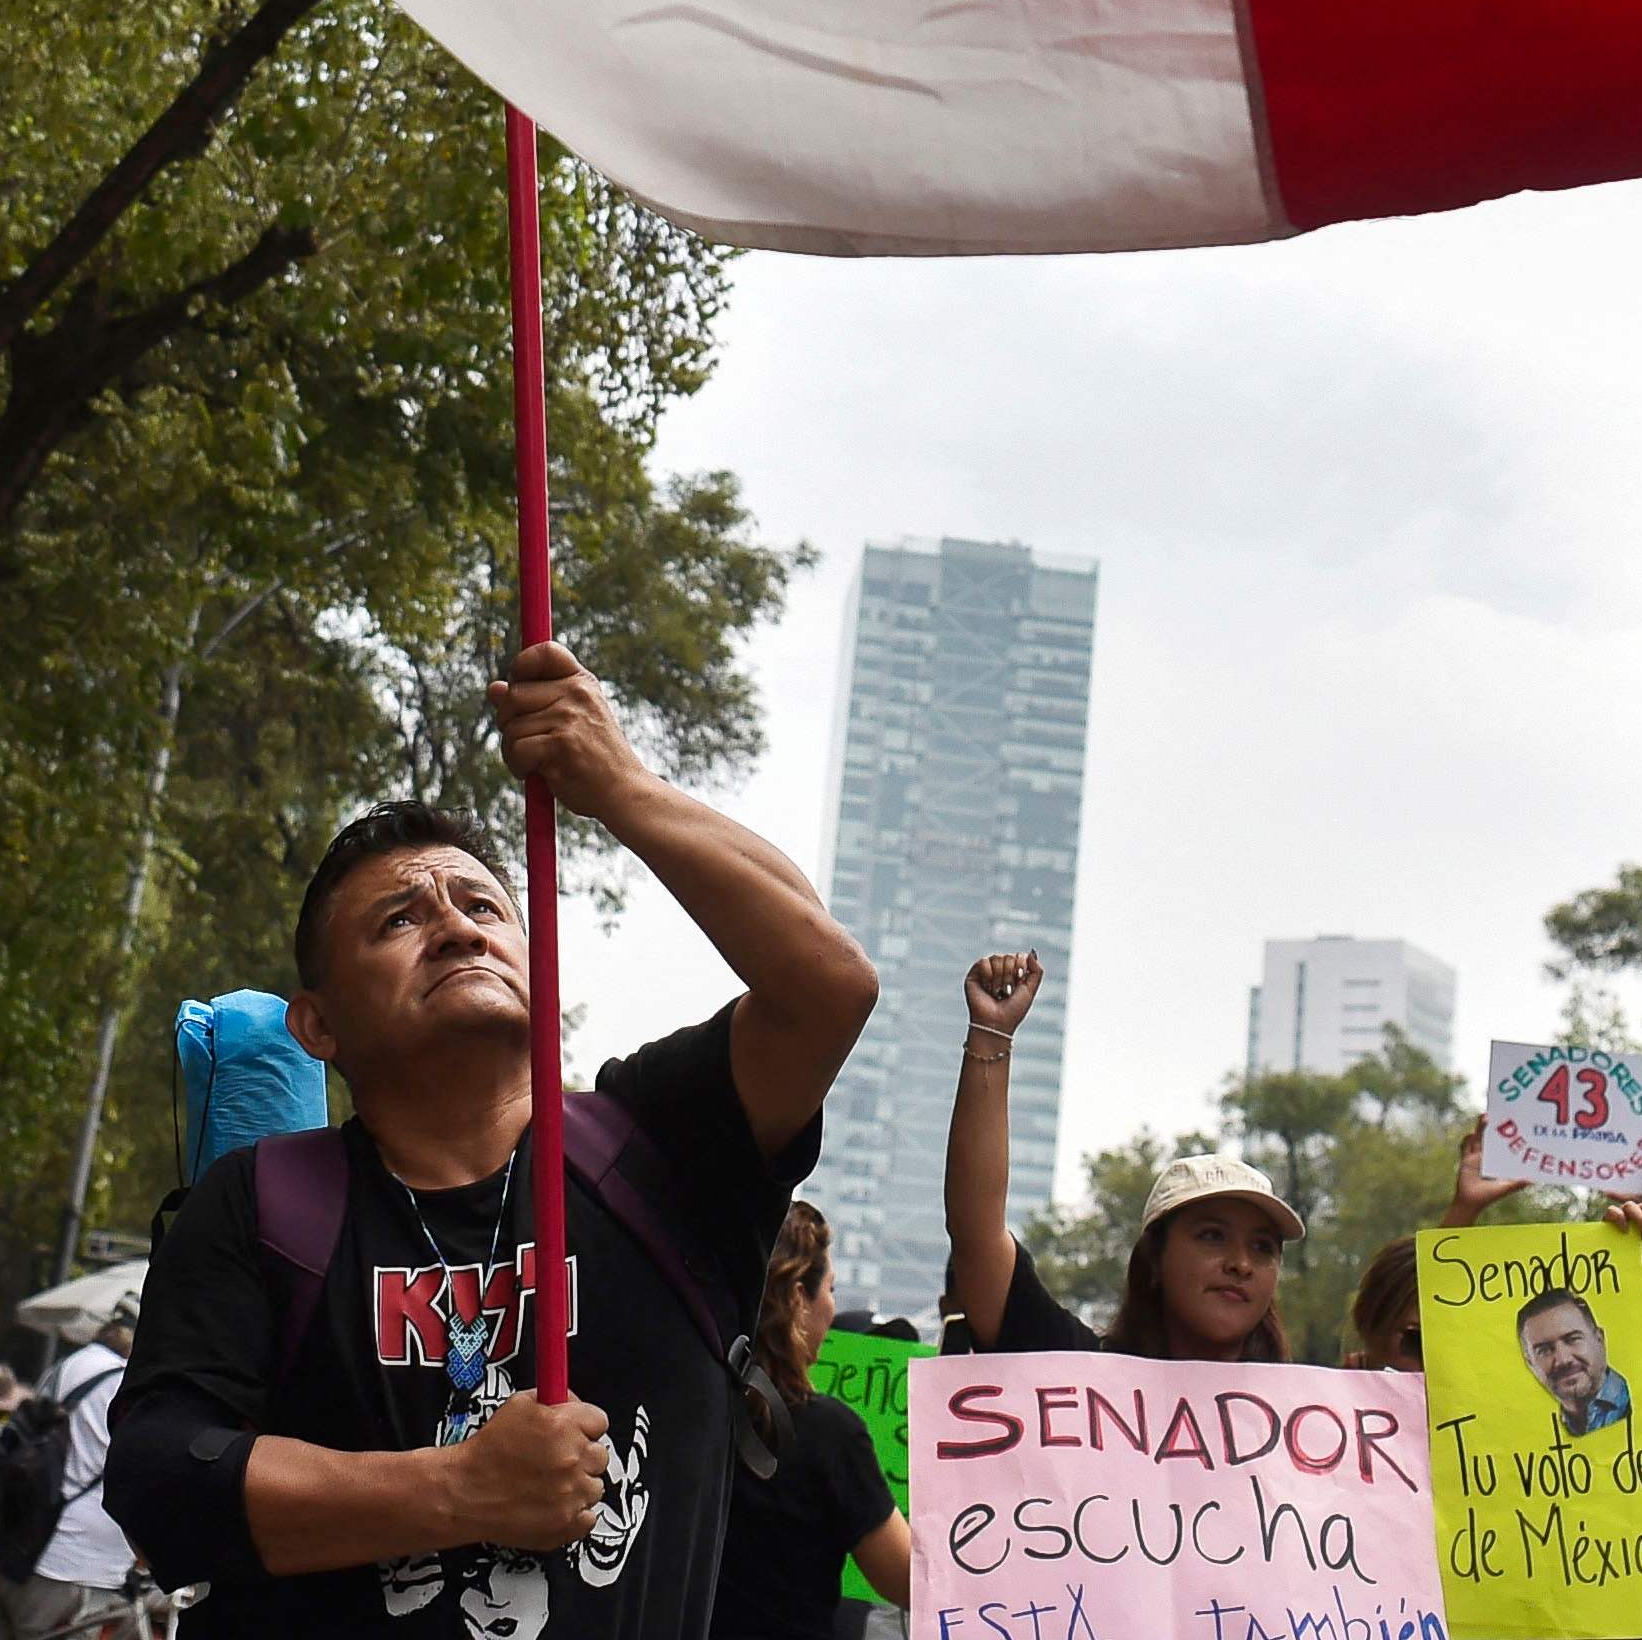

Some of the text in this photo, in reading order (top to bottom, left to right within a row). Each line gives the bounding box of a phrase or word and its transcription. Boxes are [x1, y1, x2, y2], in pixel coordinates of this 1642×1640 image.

[1538, 1064, 1610, 1129] 43
[374, 1242, 578, 1368] KIS
[1433, 1232, 1620, 1307] Senador
[937, 1385, 1419, 1494] SENADOR
[1437, 1414, 1496, 1497] Tu
[1515, 1413, 1593, 1499] voto
[948, 1475, 1379, 1585] escucha
[1451, 1507, 1505, 1583] de
